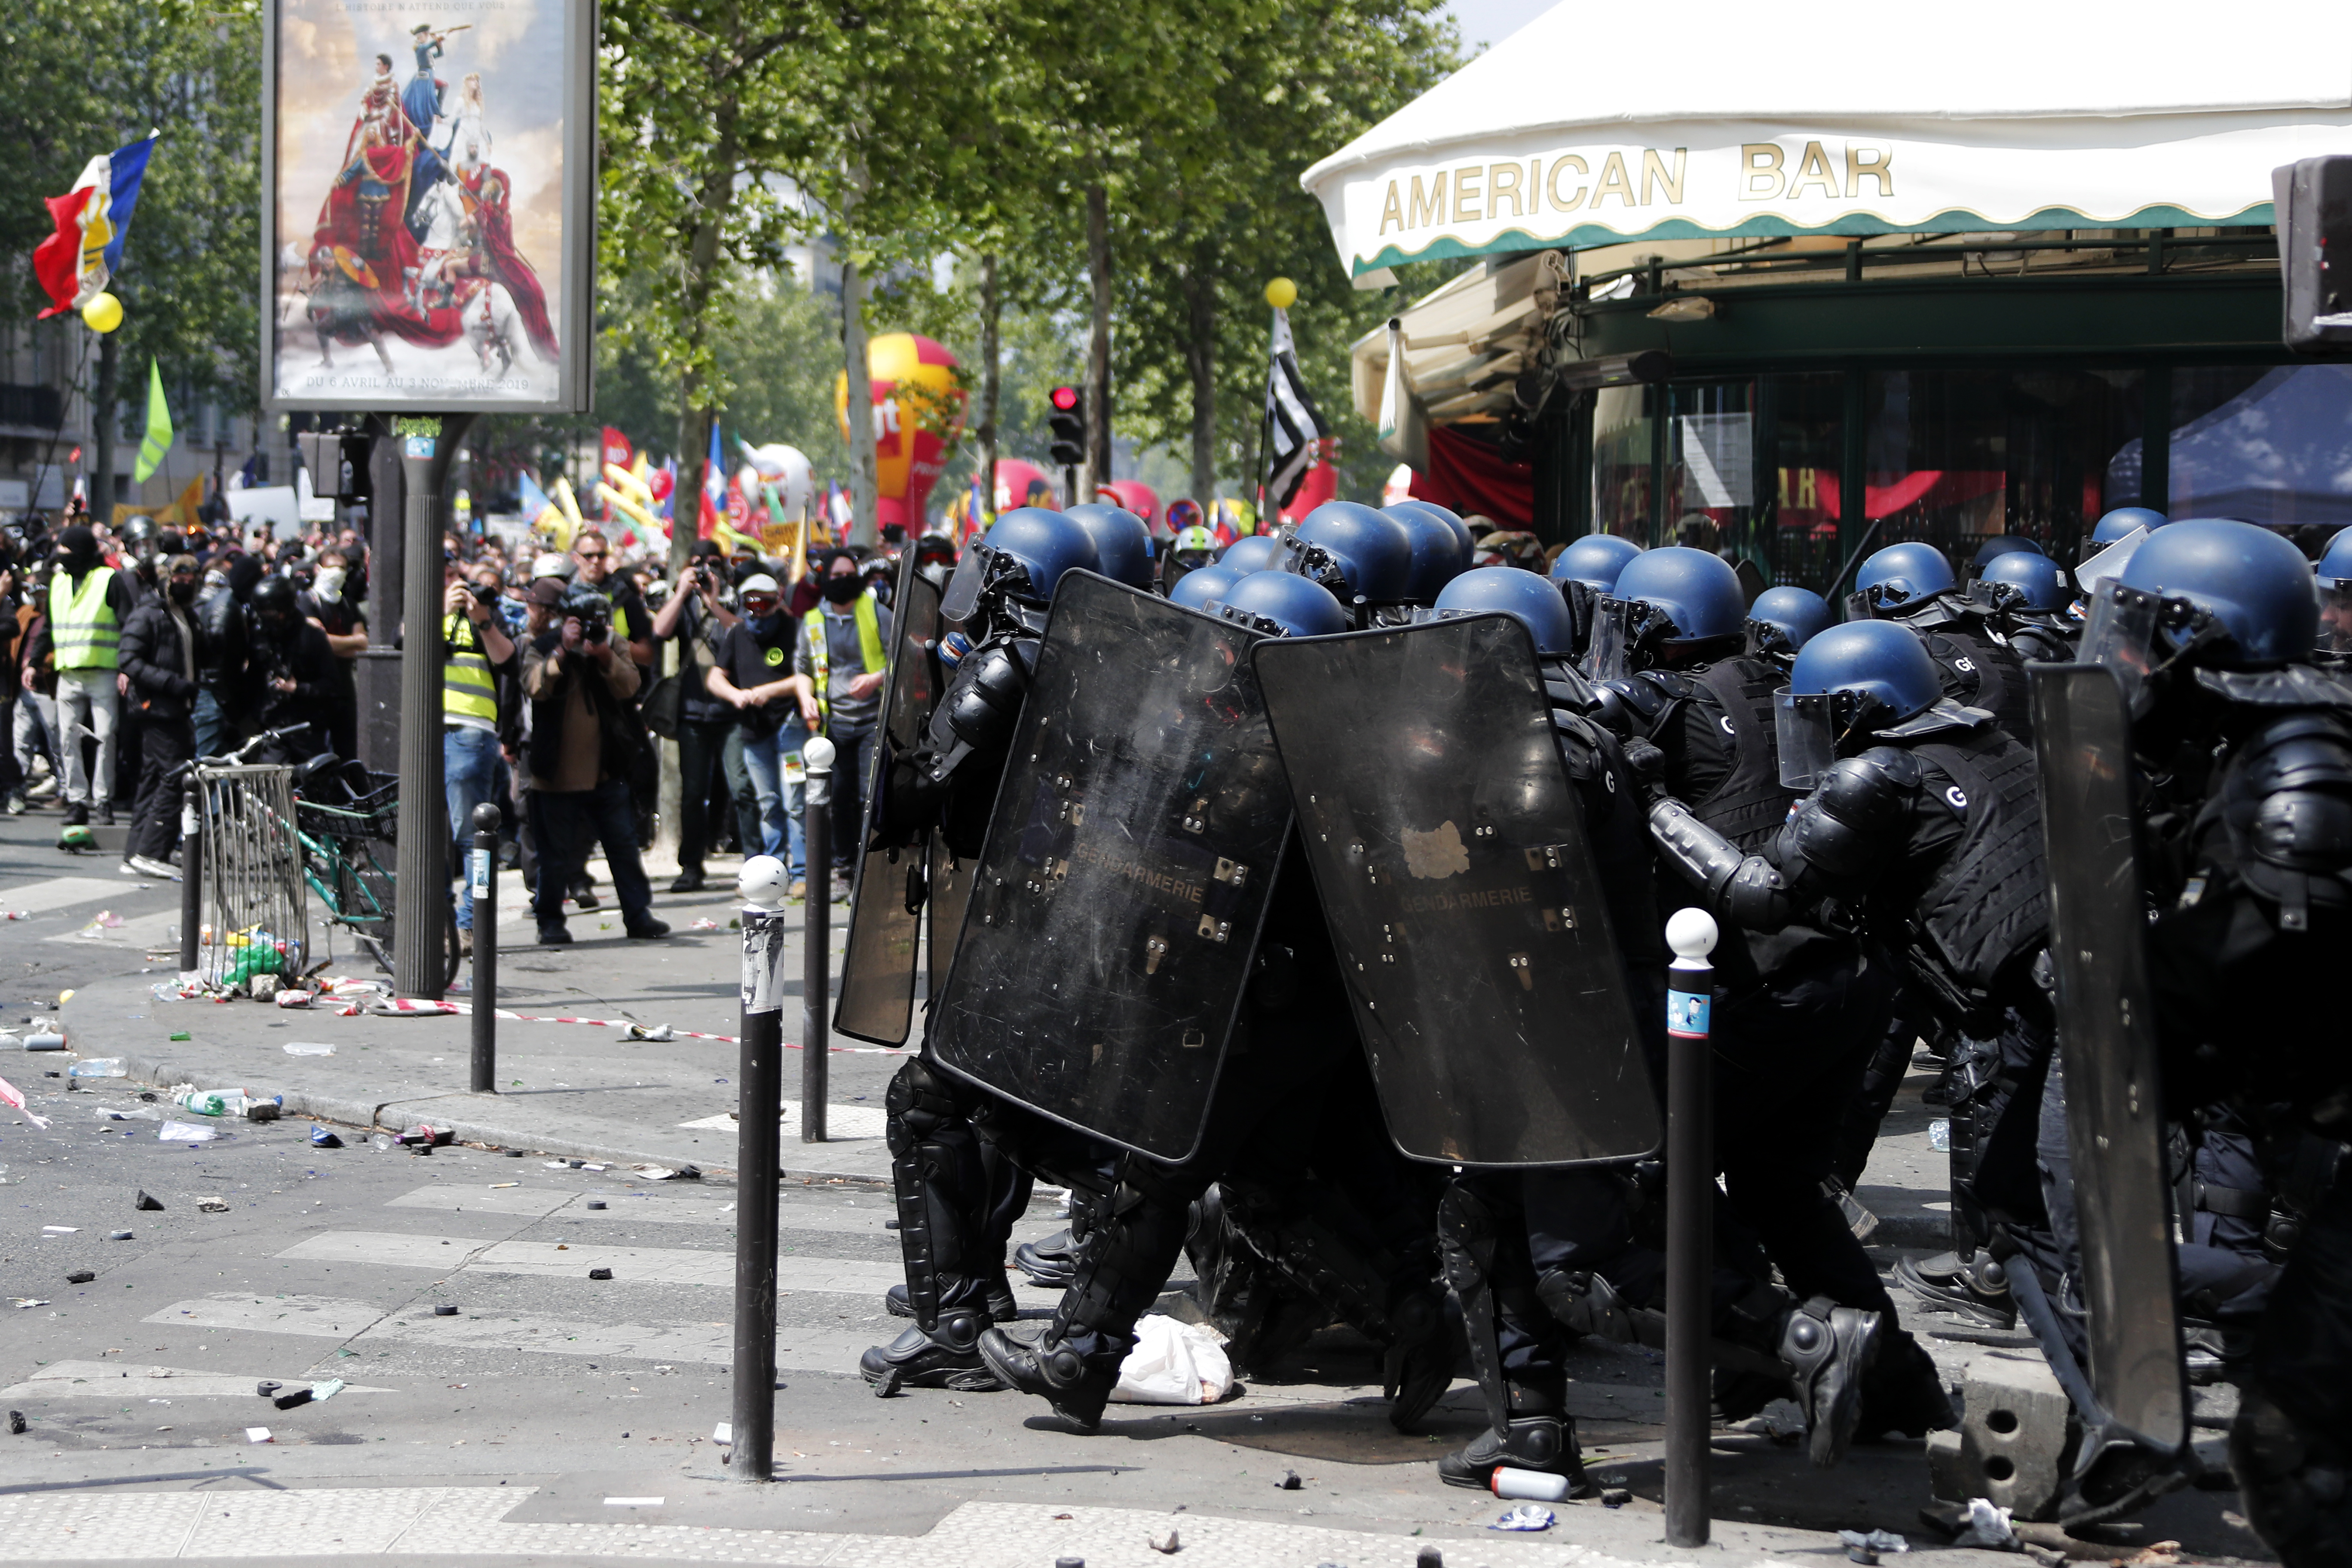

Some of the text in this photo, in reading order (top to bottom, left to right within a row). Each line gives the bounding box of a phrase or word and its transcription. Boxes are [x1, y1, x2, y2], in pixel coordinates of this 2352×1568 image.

[479, 1, 505, 9] VOUS
[1379, 140, 1896, 236] AMERICAN BAR
[307, 376, 529, 389] DU 6 AVRIL AU 3 NOVMBRE 2019
[1605, 770, 1615, 793] G
[1946, 786, 1968, 807] G
[1077, 842, 1204, 903] GENDARMERIE
[1400, 886, 1533, 912] GENDARMERIE
